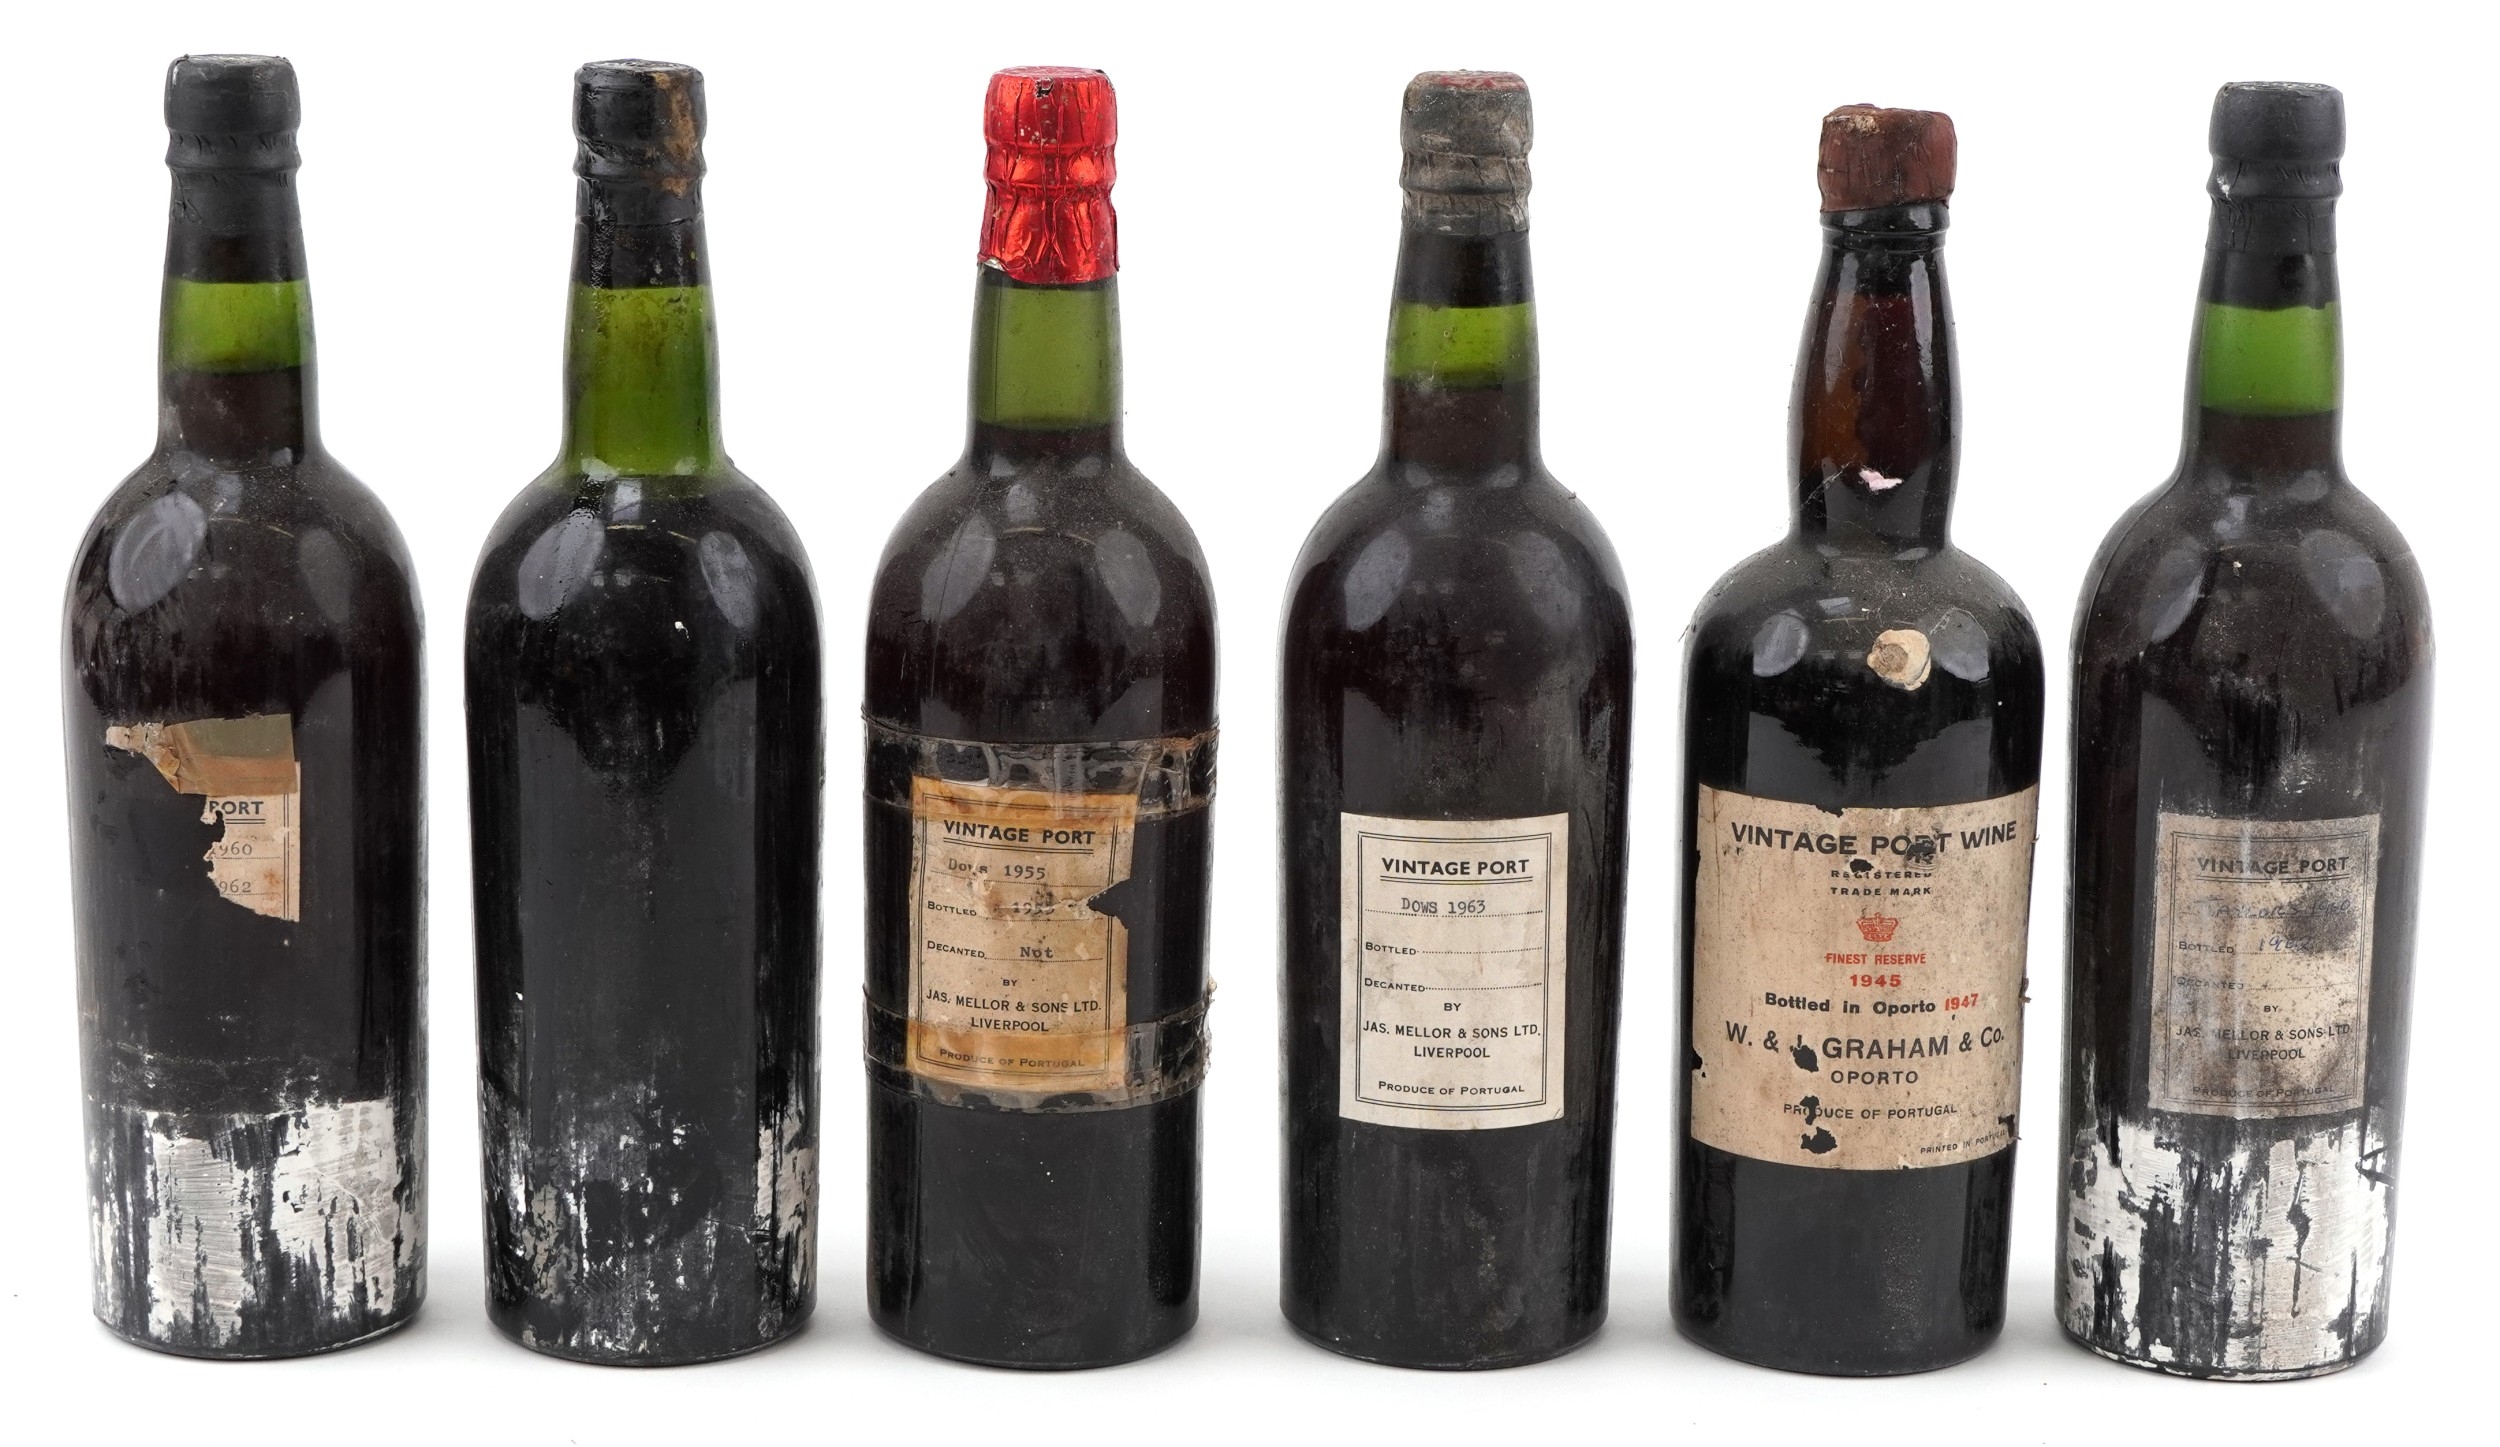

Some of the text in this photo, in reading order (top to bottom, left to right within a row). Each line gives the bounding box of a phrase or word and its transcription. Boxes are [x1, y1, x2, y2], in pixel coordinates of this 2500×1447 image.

[209, 801, 264, 815] PORT
[943, 819, 1096, 845] VINTAGE PORT
[1731, 822, 1858, 856] VINTAGE
[1960, 820, 2018, 850] WINE
[1004, 864, 1046, 880] 1955
[1381, 857, 1530, 876] VINTAGE PORT
[2198, 857, 2350, 875] VINTAGE PORT
[1830, 887, 1933, 897] TRADE MARK
[1401, 897, 1486, 914] DOWS 1963
[1019, 946, 1054, 959] Not
[1825, 953, 1927, 965] FINEST RESERVE
[1002, 978, 1018, 987] BY
[1849, 974, 1901, 989] 1945
[926, 988, 1101, 1013] JAS. MELLOR & SONS LTD.
[1444, 1003, 1462, 1012] BY
[1765, 992, 1979, 1017] Bottled in Oporto 1947
[2263, 1005, 2279, 1013] BY
[970, 1017, 1049, 1032] LIVERPOOL
[1363, 1020, 1541, 1039] JAS. MELLOR & SONS LTD.
[1725, 1020, 1753, 1046] W.
[1763, 1030, 1779, 1053] &
[1821, 1035, 1949, 1060] GRAHAM
[1959, 1032, 1972, 1053] &
[1980, 1026, 2005, 1048] Co.
[2176, 1026, 2205, 1038] JAS.
[2275, 1030, 2284, 1040] &
[2289, 1028, 2323, 1040] SONS
[1414, 1045, 1491, 1059] LIVERPOOL
[2229, 1047, 2306, 1060] LIVERPOOL
[1830, 1070, 1919, 1085] OPORTO
[1861, 1109, 1881, 1119] OF
[1887, 1104, 1957, 1119] PORTUGAL
[1920, 1143, 1958, 1154] PRINTED
[1963, 1140, 1971, 1149] IN
